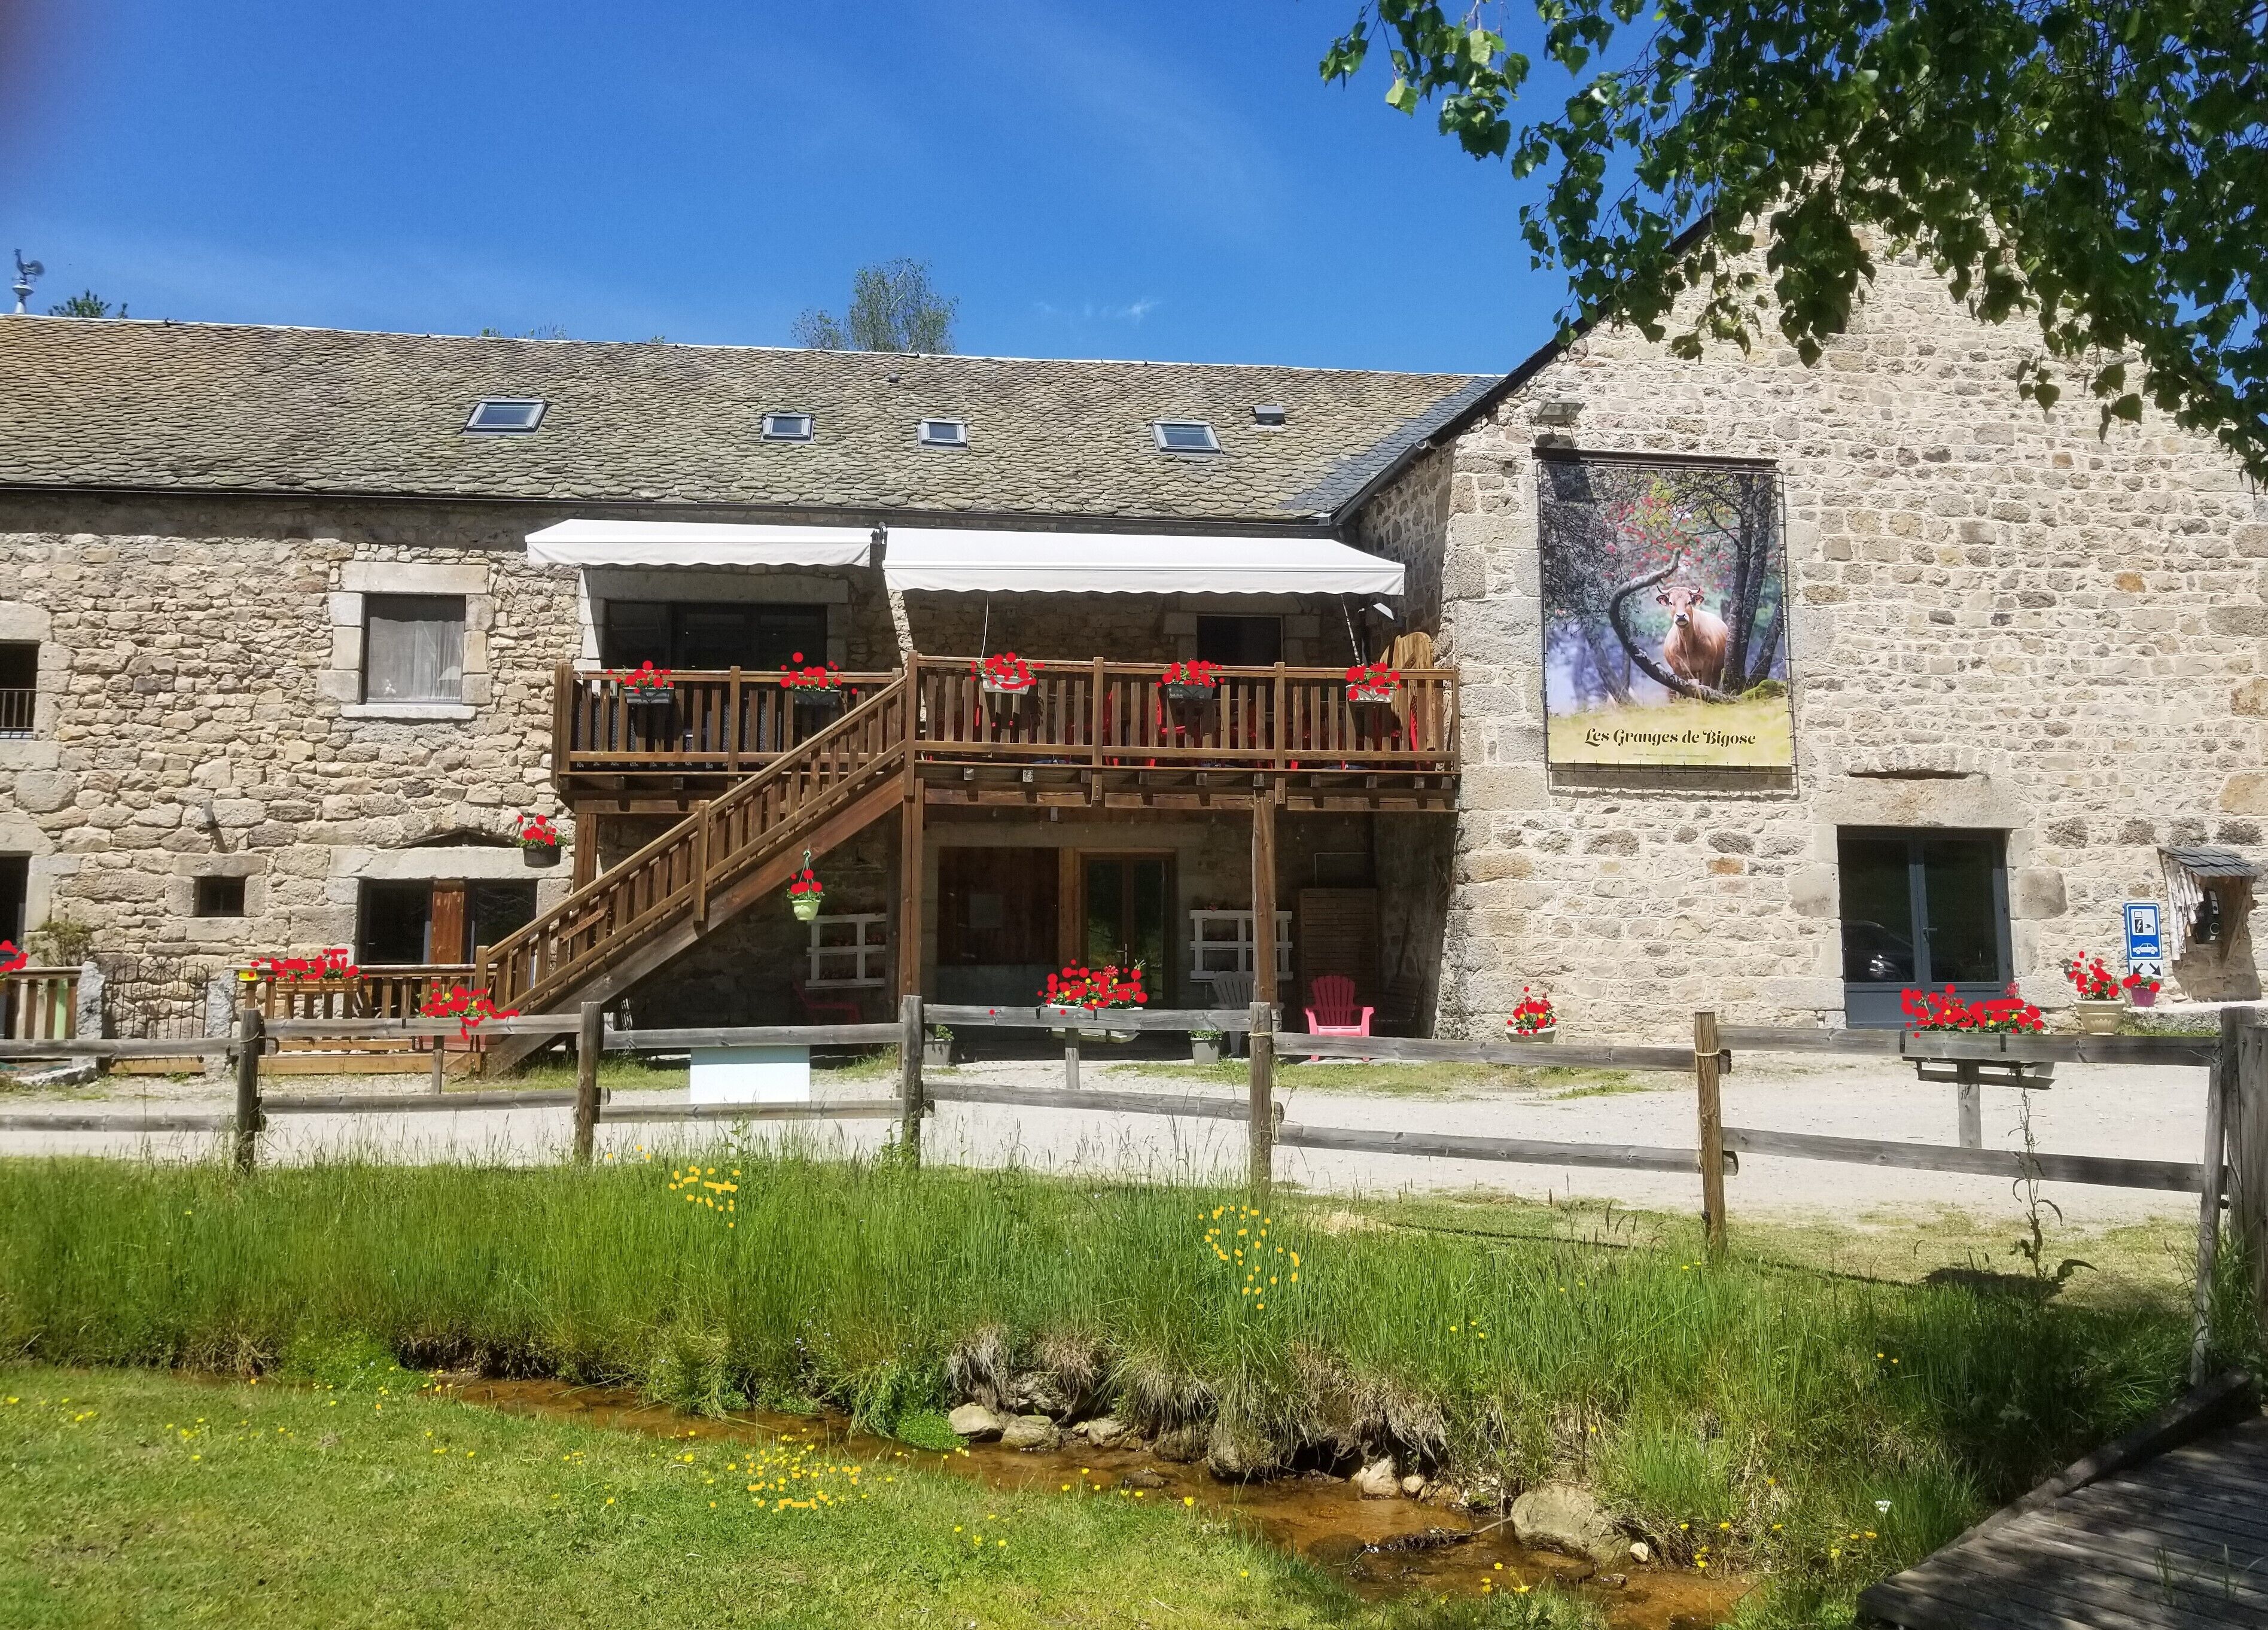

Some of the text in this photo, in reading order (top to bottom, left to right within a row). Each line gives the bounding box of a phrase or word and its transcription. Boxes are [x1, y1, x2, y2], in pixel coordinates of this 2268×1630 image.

[1585, 728, 1756, 748] Les Granges de Bigose
